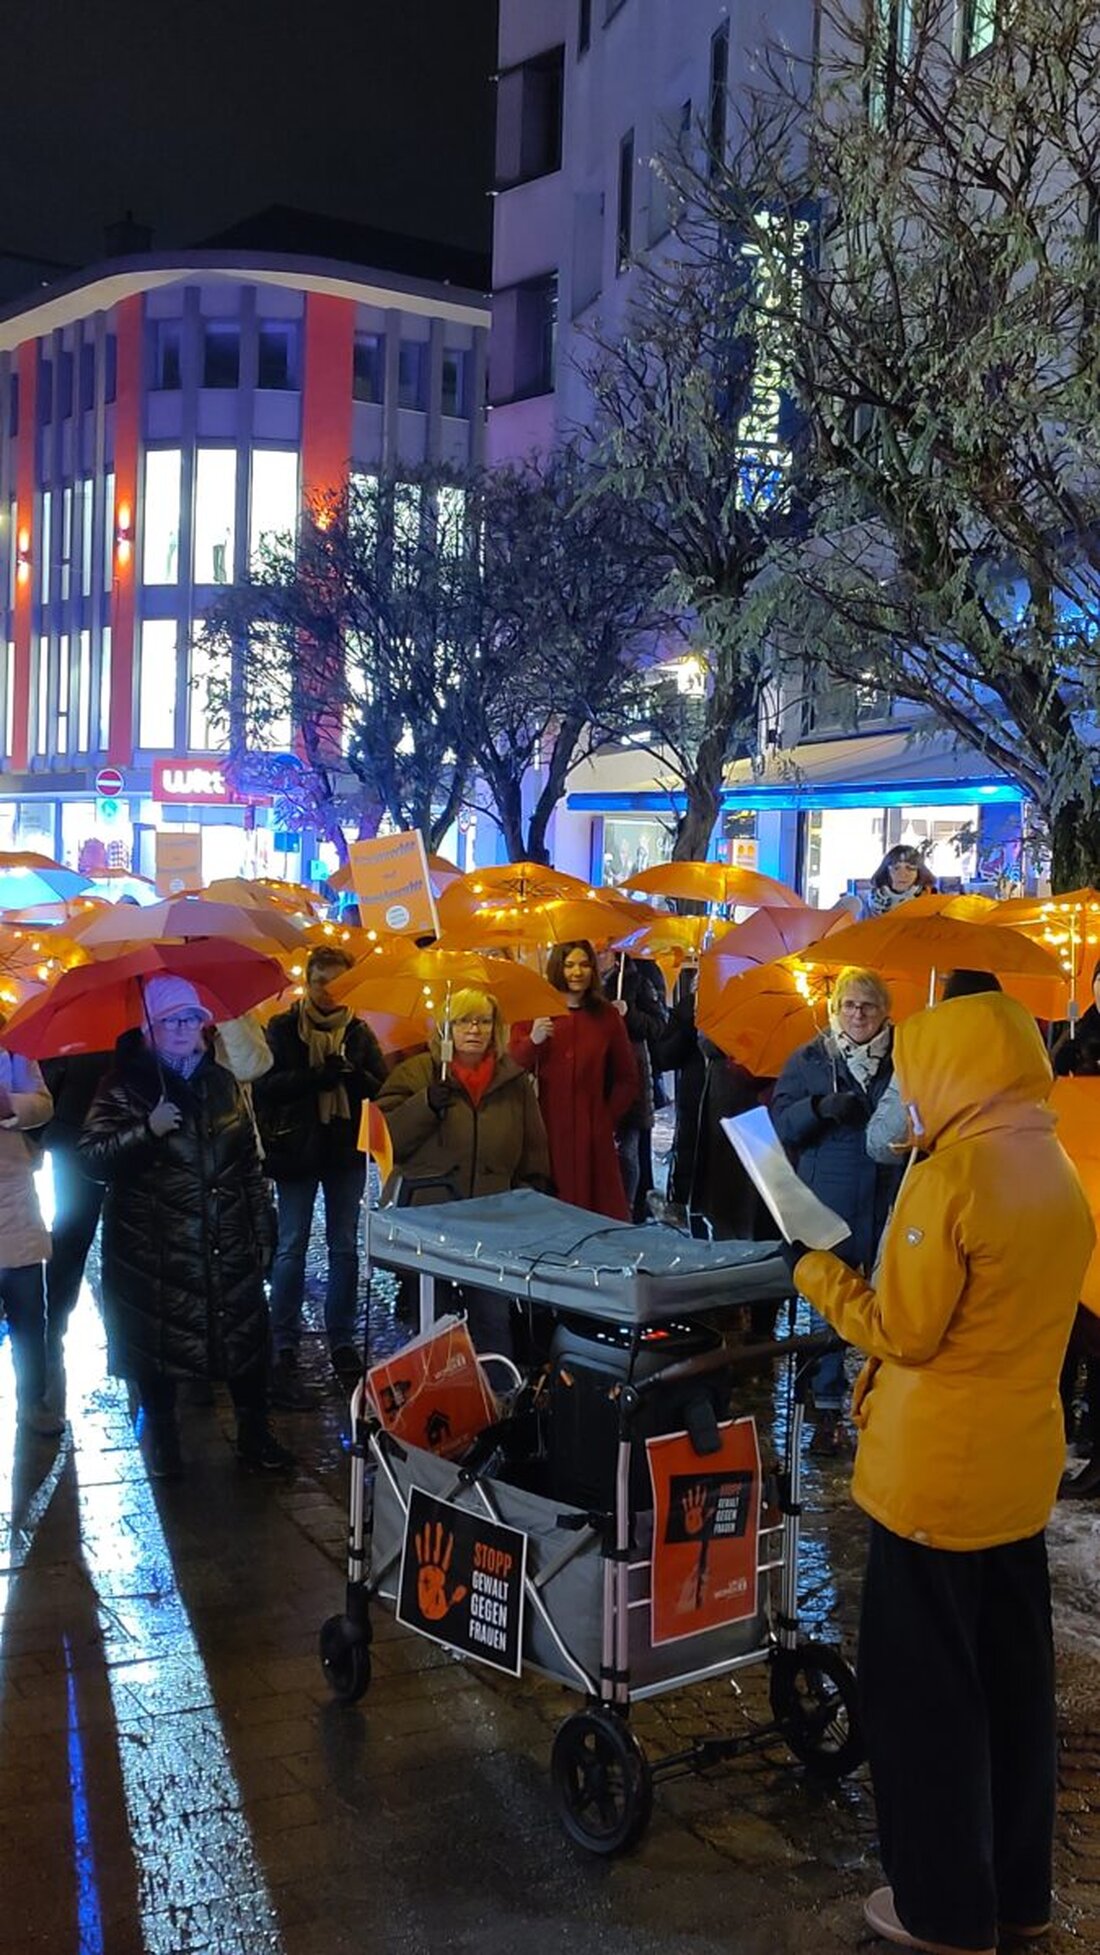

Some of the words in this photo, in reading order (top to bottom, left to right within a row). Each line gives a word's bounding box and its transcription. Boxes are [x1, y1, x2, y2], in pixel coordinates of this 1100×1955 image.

[473, 1541, 512, 1578] STOPP
[472, 1570, 509, 1602] GEWALT
[470, 1592, 508, 1629] GEGEN
[469, 1618, 506, 1652] FRAUEN
